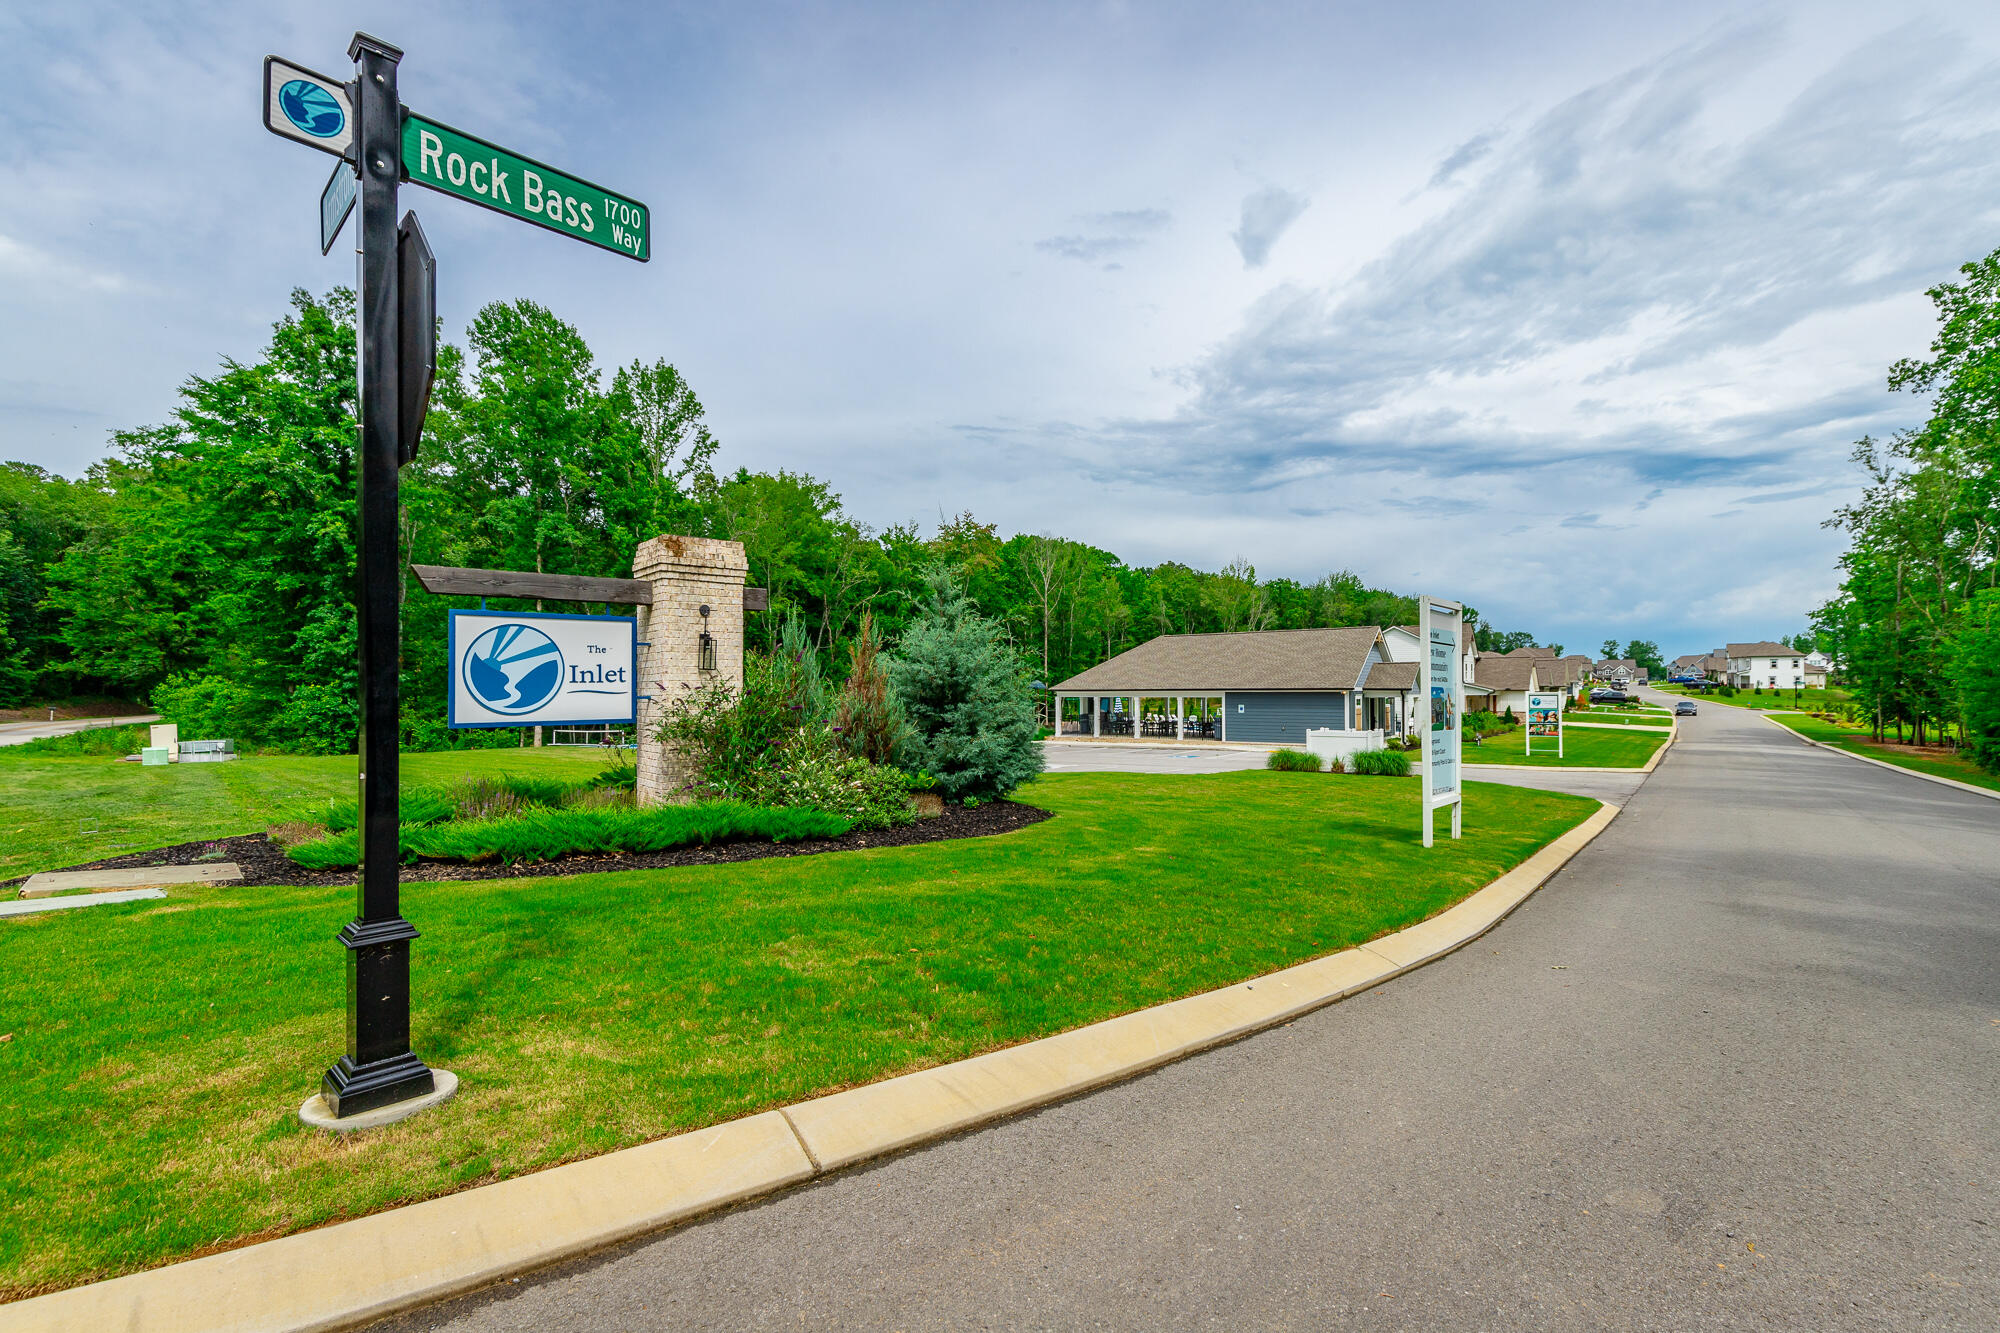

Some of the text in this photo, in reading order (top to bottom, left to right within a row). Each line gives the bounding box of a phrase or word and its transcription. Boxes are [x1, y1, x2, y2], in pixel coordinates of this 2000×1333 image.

[420, 129, 594, 233] Rock Bass
[604, 198, 641, 229] 1700
[612, 225, 642, 256] Way
[587, 645, 607, 654] The
[569, 664, 626, 683] Inlet
